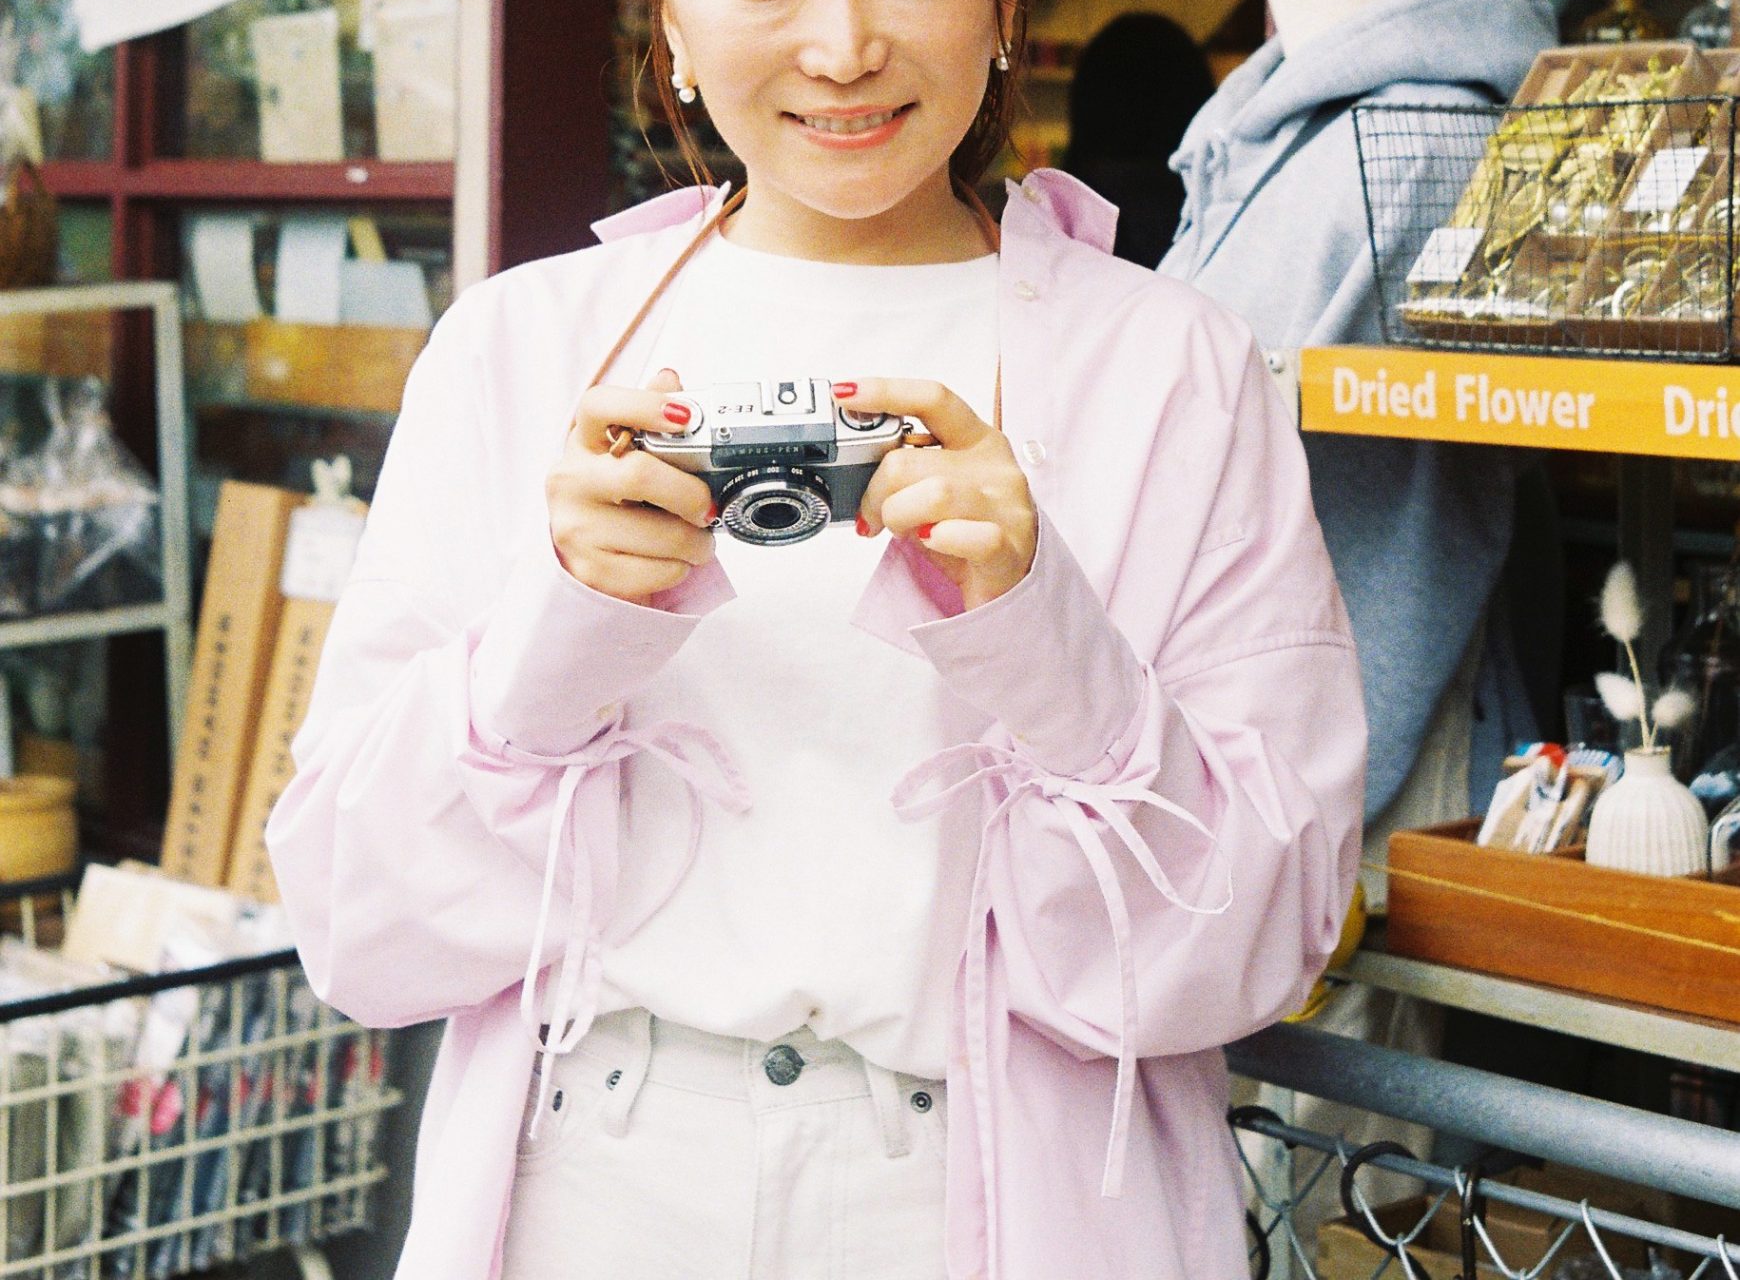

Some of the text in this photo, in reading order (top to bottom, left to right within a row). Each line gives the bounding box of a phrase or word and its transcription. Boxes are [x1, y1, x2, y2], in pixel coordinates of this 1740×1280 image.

[717, 404, 754, 415] EE-2
[1333, 366, 1437, 418] Dried
[1454, 374, 1596, 429] Flower
